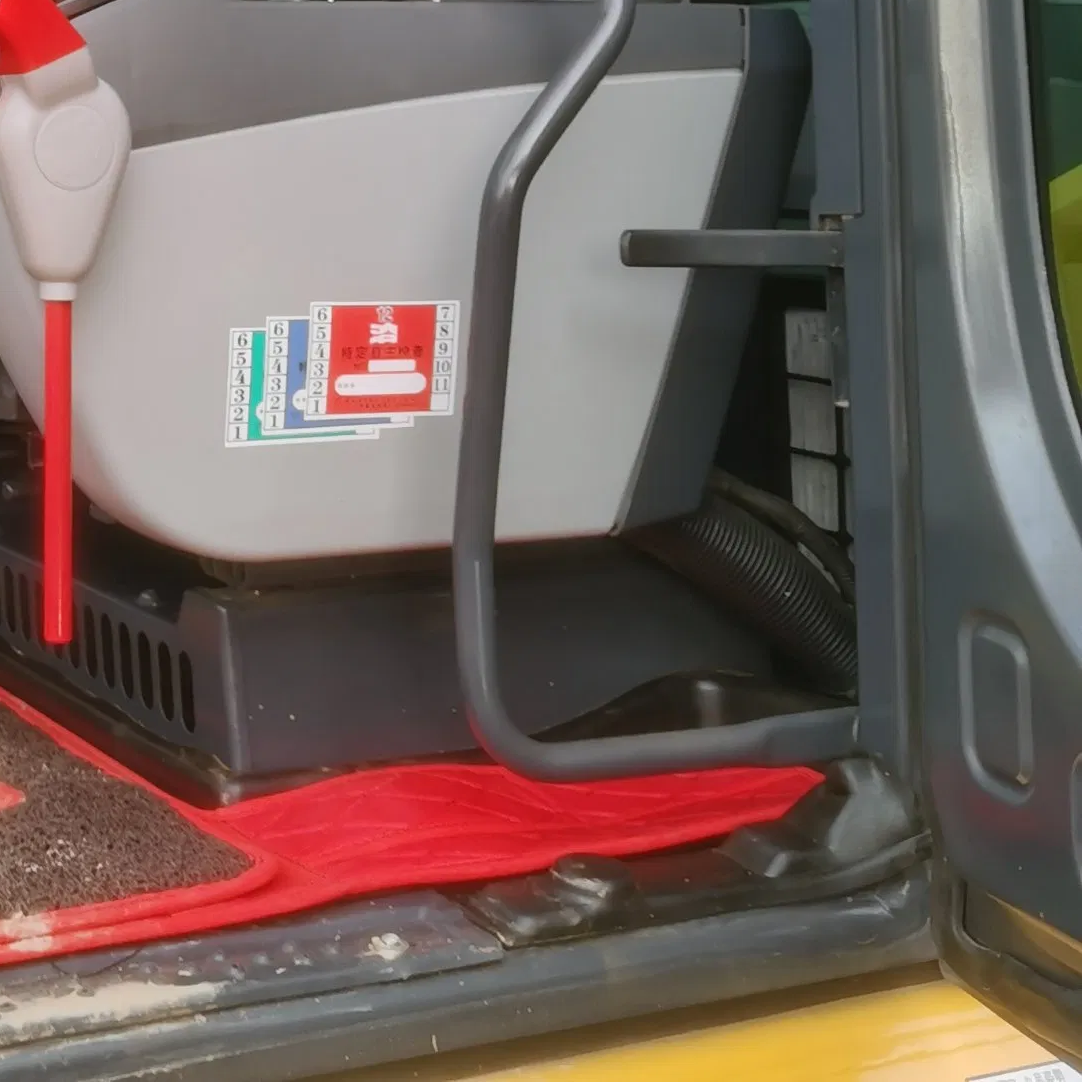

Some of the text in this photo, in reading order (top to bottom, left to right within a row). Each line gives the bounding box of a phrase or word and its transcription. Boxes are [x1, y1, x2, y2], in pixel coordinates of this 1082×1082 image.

[317, 307, 328, 321] 6
[441, 307, 450, 319] 7
[274, 321, 284, 335] 6
[316, 326, 326, 340] 5
[440, 325, 449, 337] 8
[237, 334, 248, 347] 6
[273, 340, 283, 355] 5
[315, 344, 325, 358] 4
[439, 343, 448, 355] 9
[236, 352, 247, 365] 5
[271, 360, 282, 373] 4
[314, 362, 324, 376] 3
[435, 361, 451, 373] 10
[235, 370, 245, 384] 4
[270, 377, 281, 391] 3
[312, 381, 323, 395] 2
[434, 379, 449, 391] 11
[234, 388, 245, 402] 3
[270, 396, 280, 410] 2
[313, 400, 321, 413] 1
[233, 407, 244, 421] 2
[271, 414, 279, 427] 1
[234, 426, 241, 439] 1
